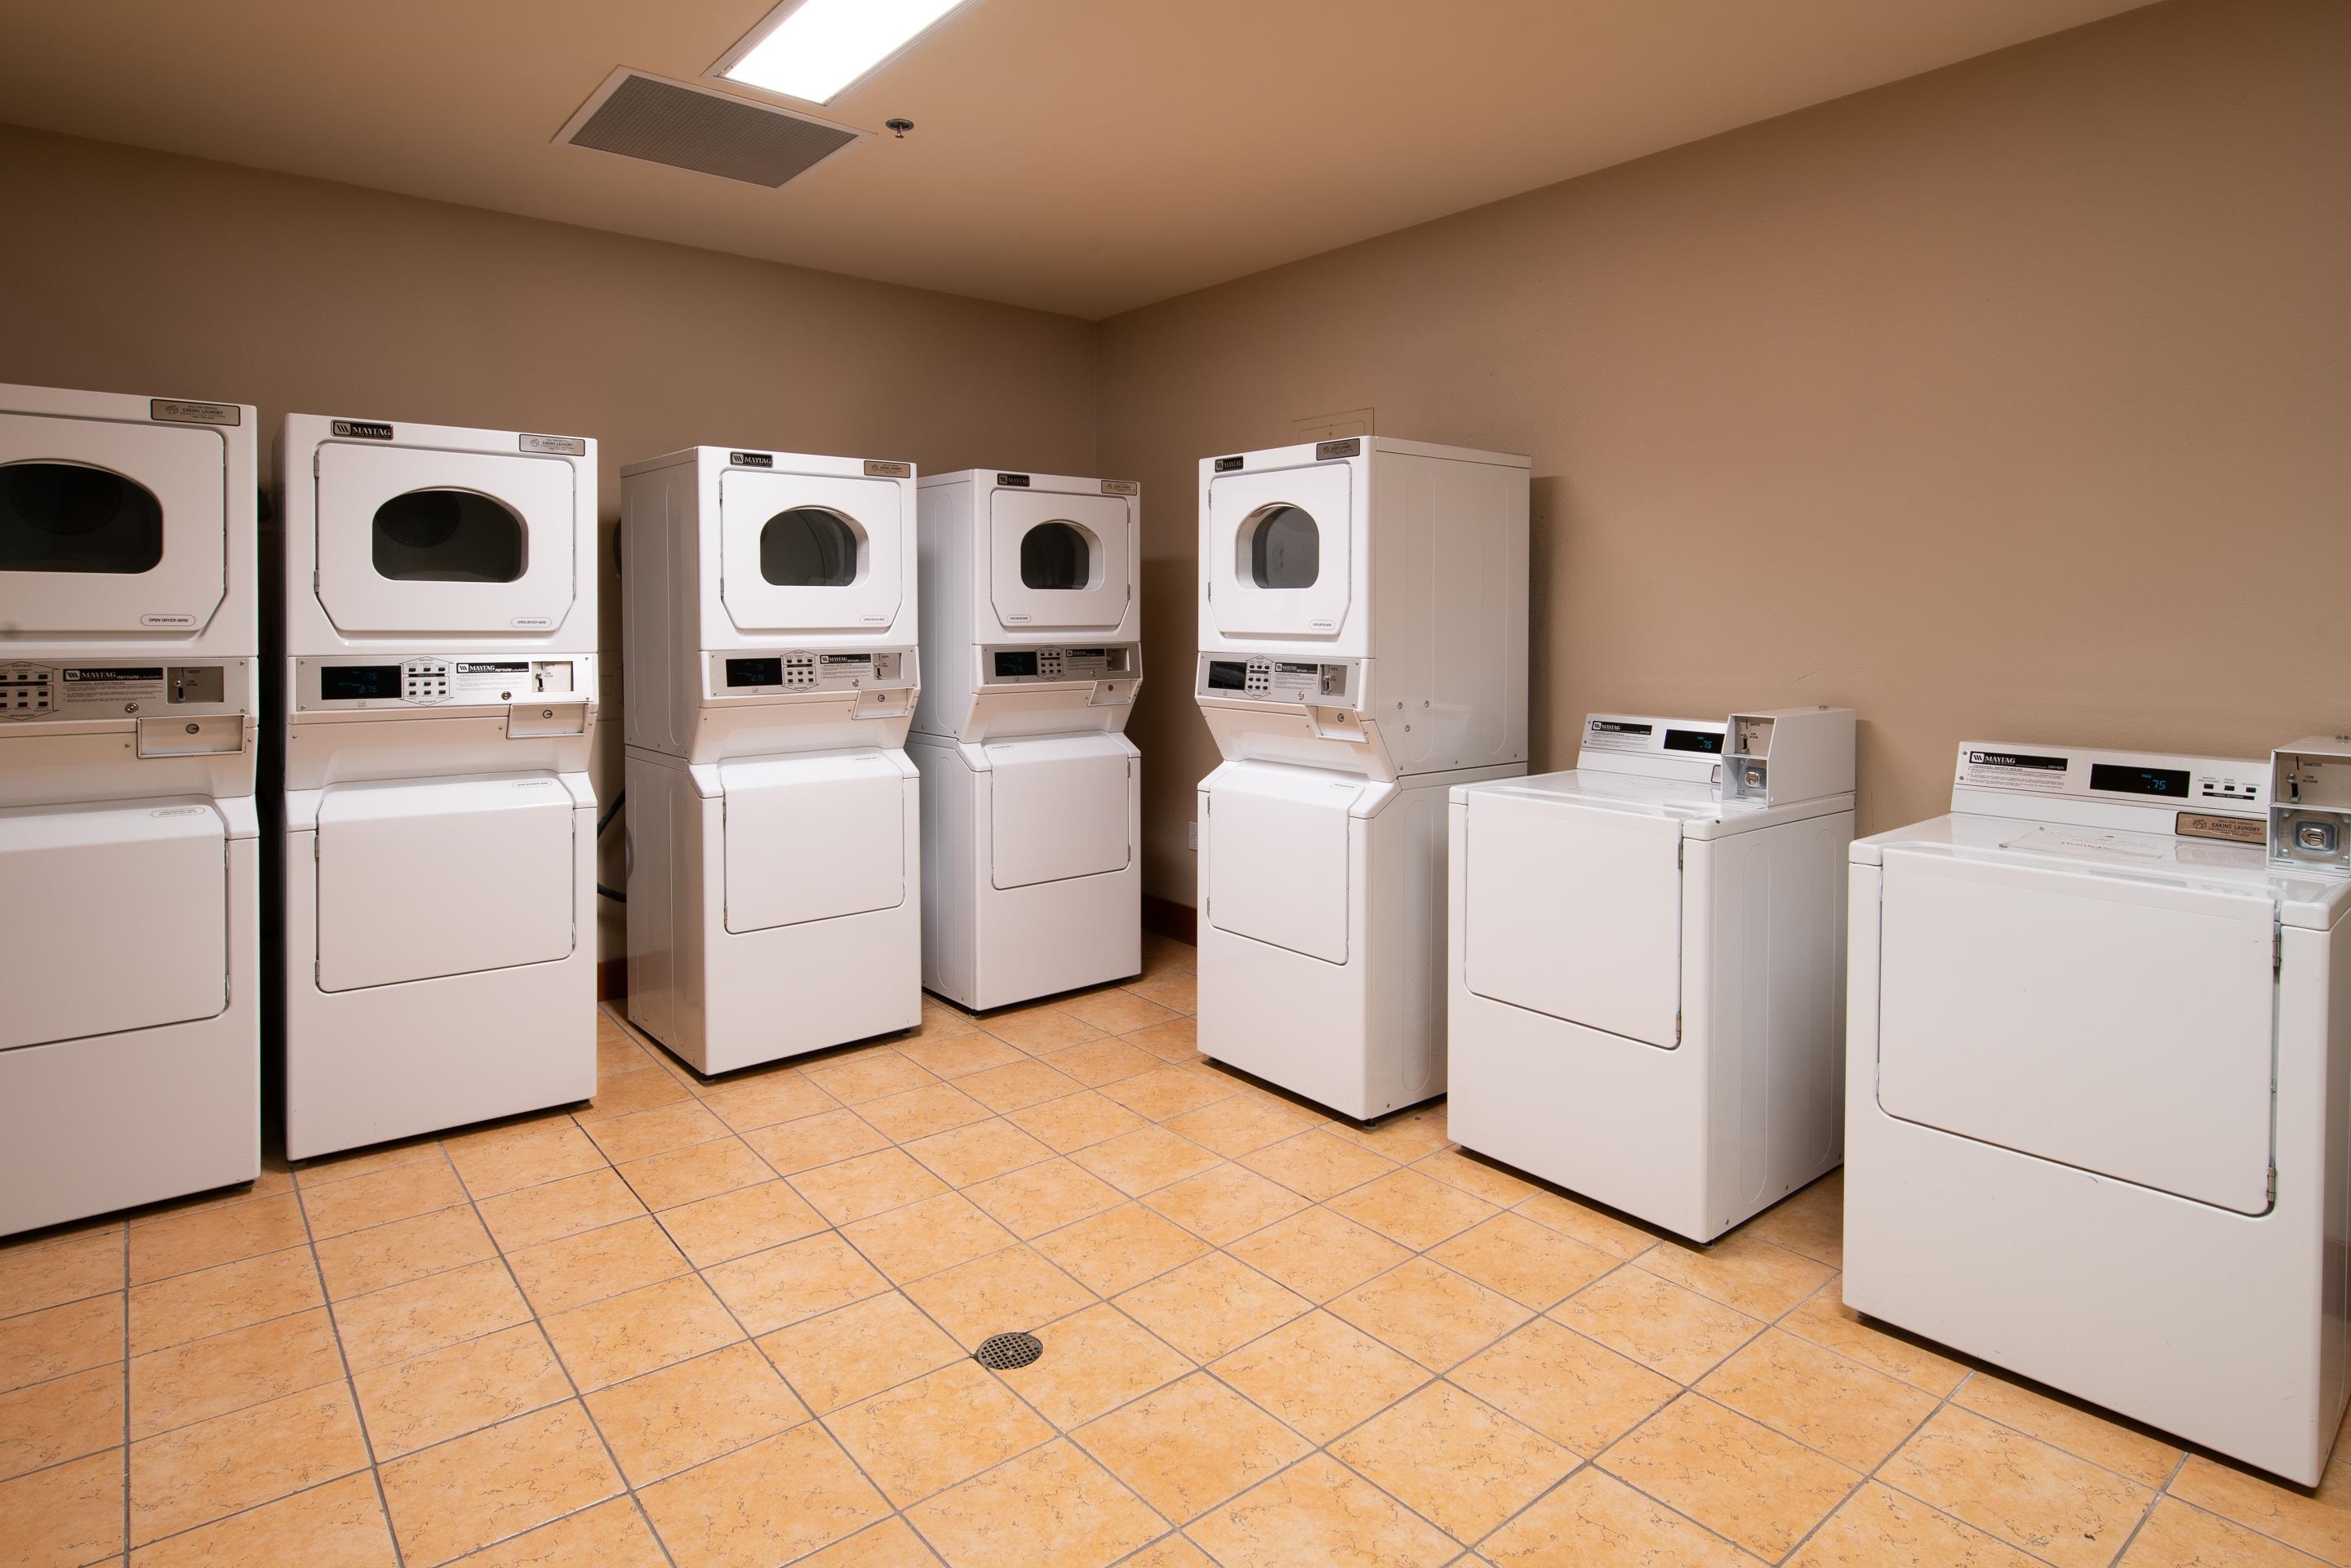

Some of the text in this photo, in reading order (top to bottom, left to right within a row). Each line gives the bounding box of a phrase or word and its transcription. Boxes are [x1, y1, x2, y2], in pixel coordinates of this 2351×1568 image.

[352, 426, 391, 436] MAYTAG
[744, 456, 771, 464] MAYTAG
[1700, 740, 1713, 749] .75
[1984, 756, 2016, 764] MAYTAG
[2147, 780, 2167, 790] .75
[2233, 824, 2260, 833] LAUNDRY
